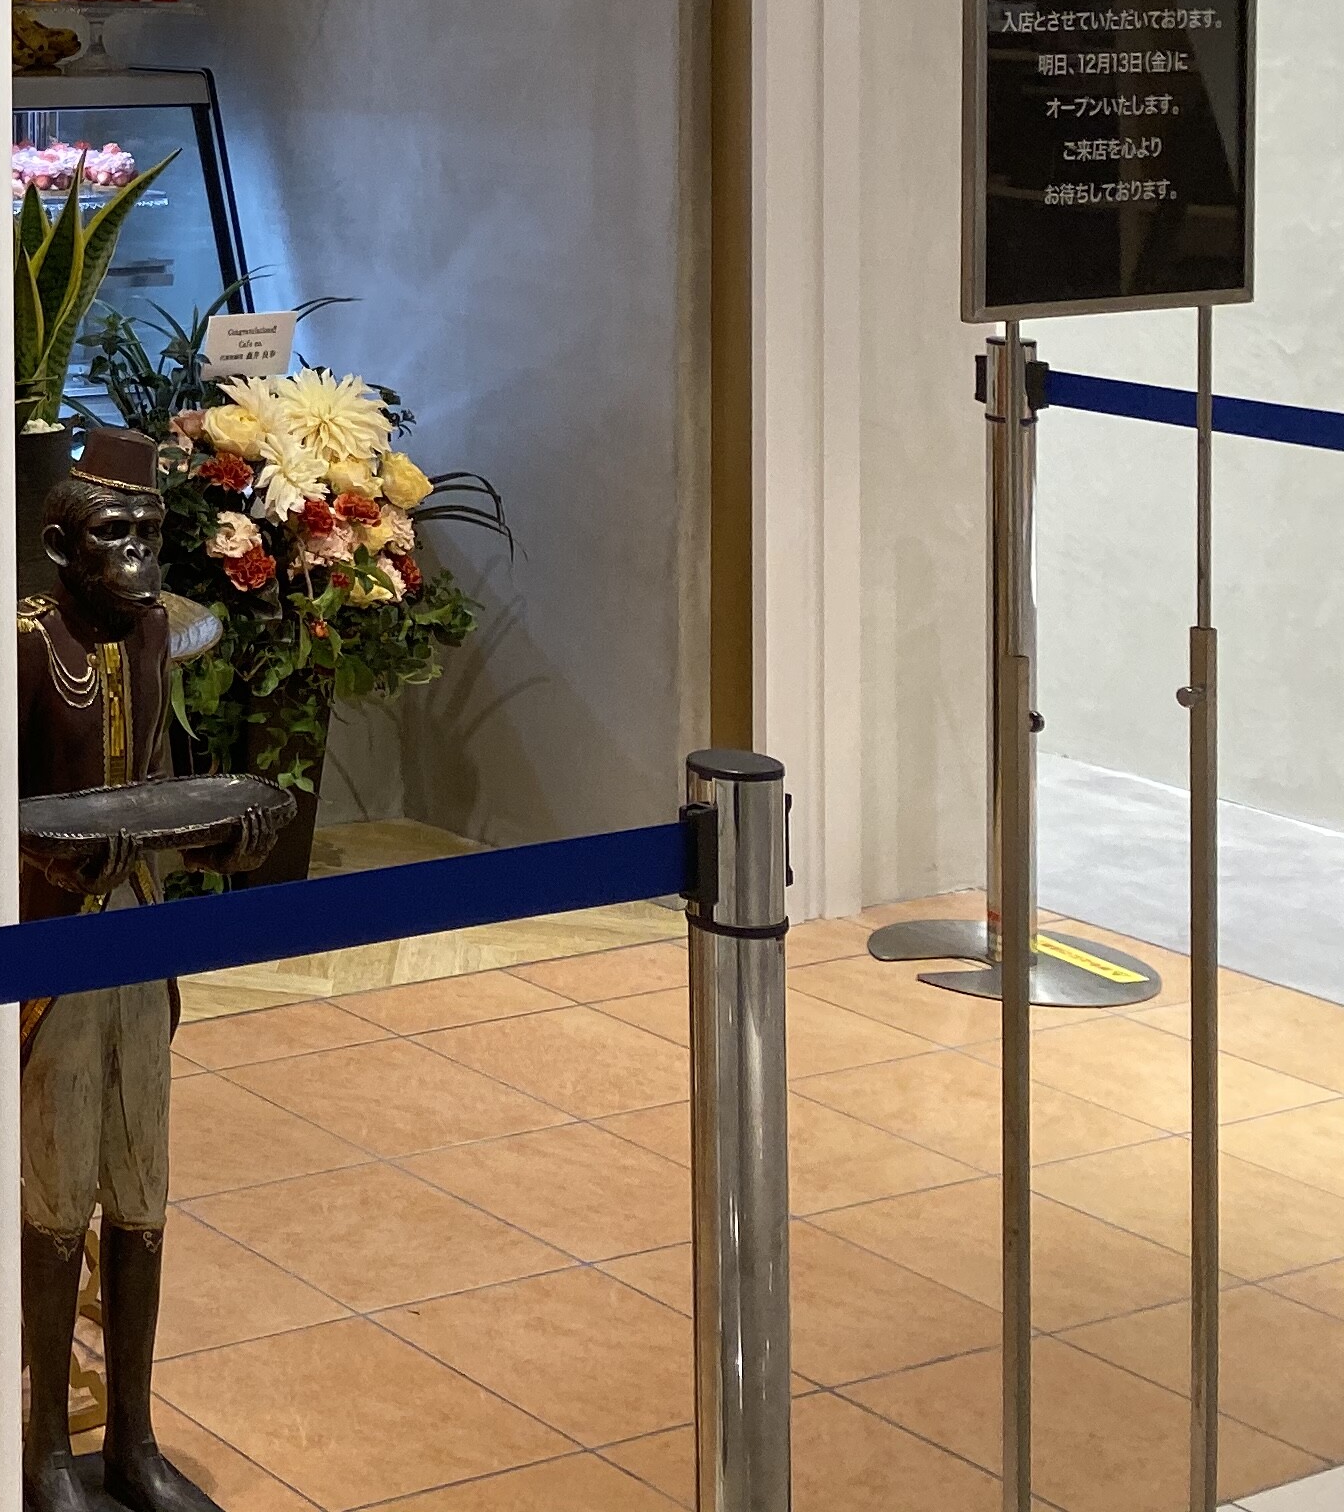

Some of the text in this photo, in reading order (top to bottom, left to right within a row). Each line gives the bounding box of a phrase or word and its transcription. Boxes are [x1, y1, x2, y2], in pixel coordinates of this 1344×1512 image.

[1001, 8, 1223, 34] 入店とさせていただいております。
[1045, 93, 1180, 120] オープンいたします。
[1062, 135, 1163, 162] ご来店を心より
[1043, 178, 1178, 206] お待ちしております。
